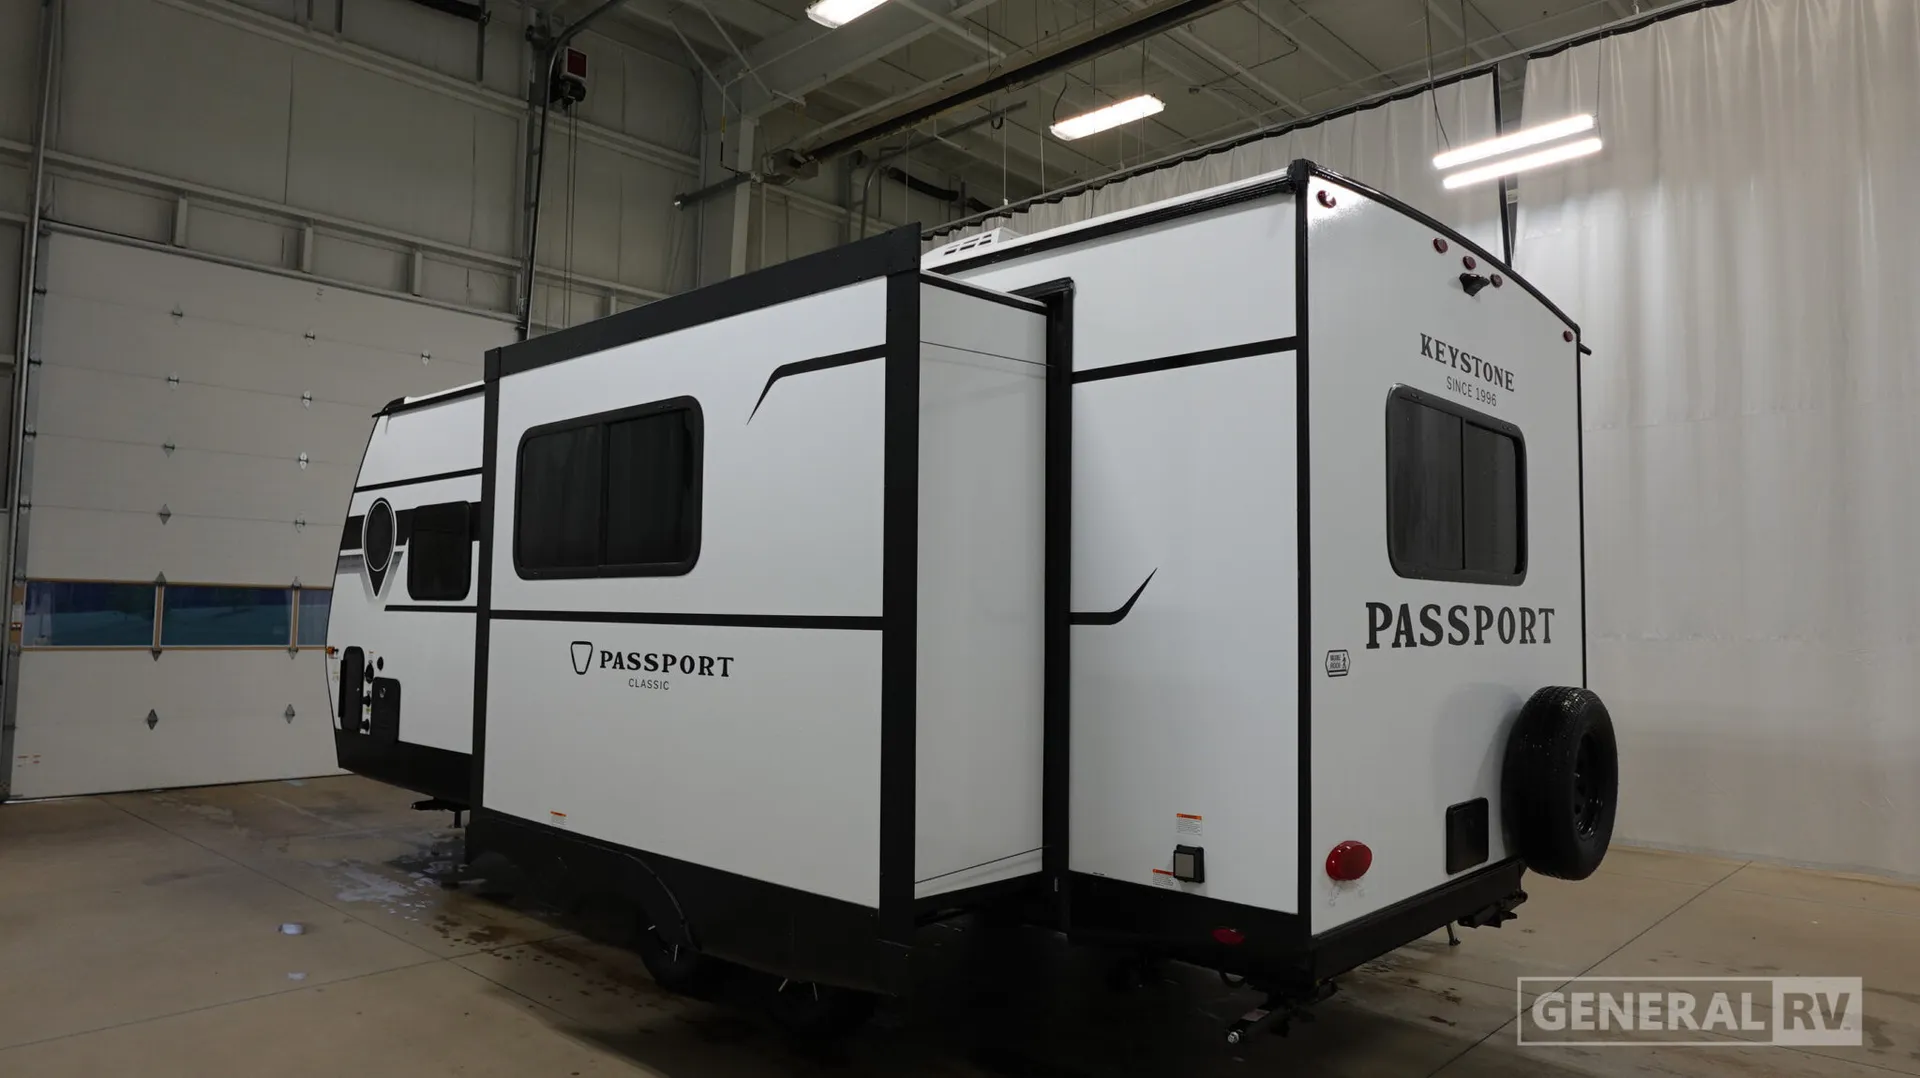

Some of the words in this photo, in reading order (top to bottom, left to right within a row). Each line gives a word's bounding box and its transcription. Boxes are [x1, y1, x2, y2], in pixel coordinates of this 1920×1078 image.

[1420, 332, 1515, 392] KEYSTONE
[1446, 376, 1473, 398] SINCE
[1475, 387, 1497, 407] 1996
[1366, 602, 1555, 649] PASSPORT
[600, 650, 735, 678] PASSPORT
[628, 678, 670, 691] CLASSIC
